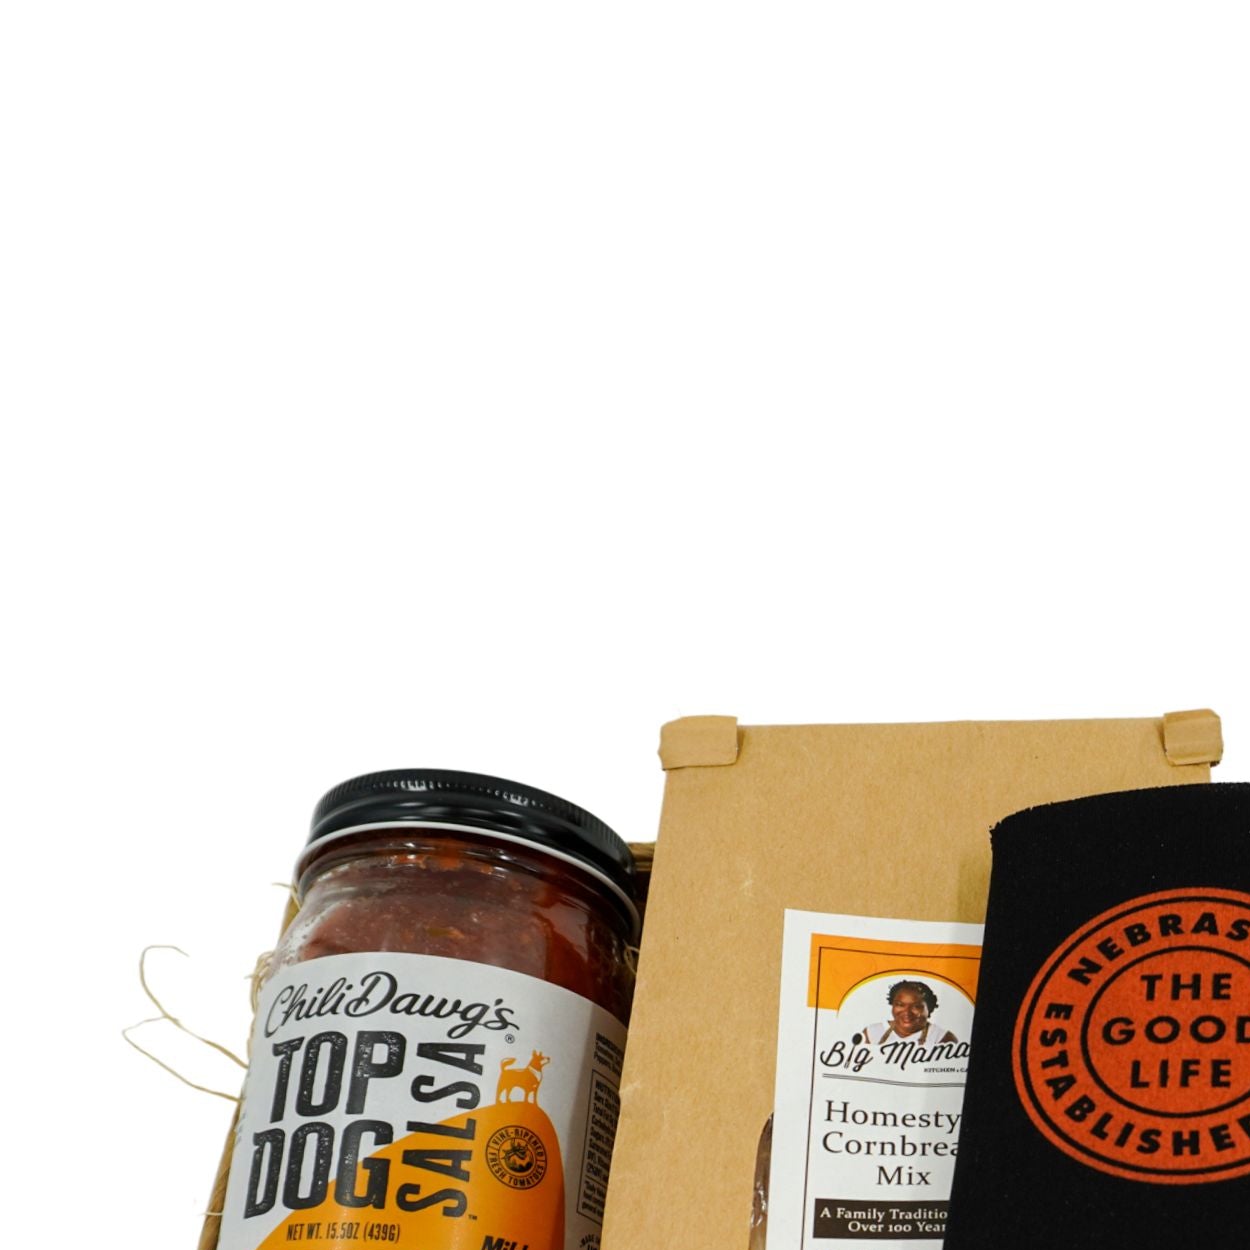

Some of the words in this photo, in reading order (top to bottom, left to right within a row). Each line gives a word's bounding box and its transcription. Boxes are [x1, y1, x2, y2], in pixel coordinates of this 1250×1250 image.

[1140, 973, 1233, 1001] THE
[820, 1033, 873, 1072] Big
[880, 1041, 969, 1070] Mama
[270, 1031, 406, 1123] TOP
[1130, 1059, 1233, 1089] LIFE
[396, 1042, 486, 1218] SALSA
[824, 1099, 961, 1134] Homesty
[822, 1131, 958, 1156] Cornbrea
[243, 1120, 393, 1219] DOG
[488, 1151, 507, 1180] FRESH
[509, 1165, 544, 1186] TOMATOES
[876, 1165, 932, 1186] Mix
[820, 1207, 831, 1218] A
[836, 1207, 885, 1223] Family
[889, 1208, 948, 1220] Traditio
[848, 1221, 884, 1233] Over
[889, 1223, 912, 1233] 100
[287, 1224, 304, 1241] NET
[306, 1223, 323, 1240] WT.
[363, 1223, 400, 1242] (439G)
